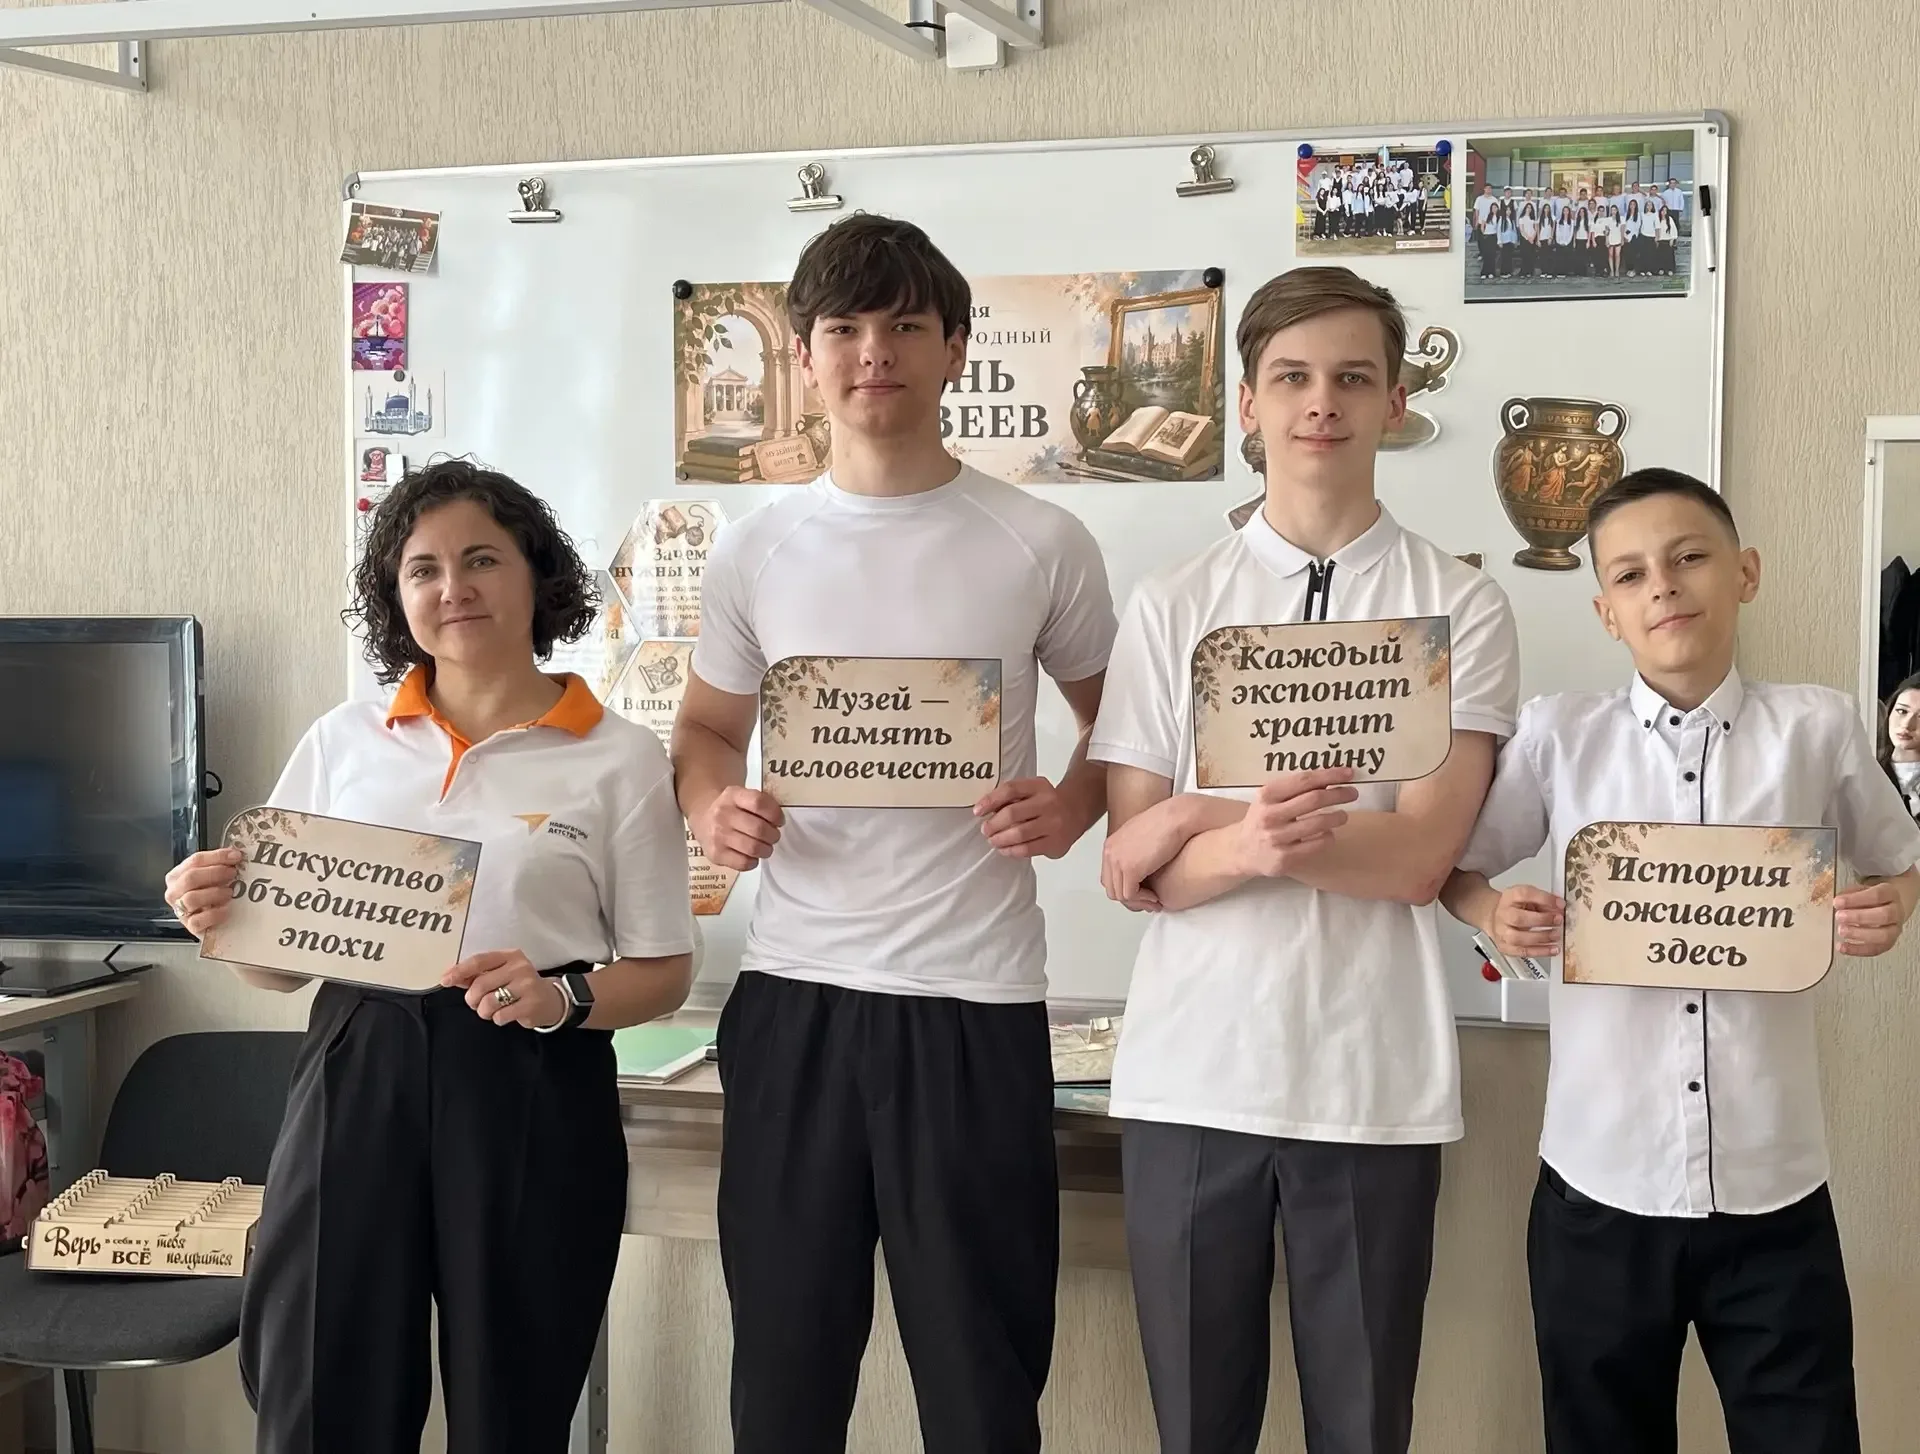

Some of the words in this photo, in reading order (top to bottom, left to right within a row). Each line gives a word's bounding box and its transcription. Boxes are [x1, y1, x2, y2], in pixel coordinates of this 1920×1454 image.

[1237, 636, 1404, 671] Каждый
[813, 686, 913, 717] Музей
[1231, 676, 1411, 705] экспонат
[811, 725, 953, 746] память
[1249, 712, 1394, 745] хранит
[768, 758, 995, 780] человечества
[1263, 742, 1385, 775] тайну
[250, 839, 445, 894] Искусство
[1607, 855, 1792, 893] История
[230, 878, 454, 934] объединяет
[1602, 899, 1795, 928] оживает
[278, 926, 386, 962] эпохи
[1646, 938, 1748, 967] здесь
[44, 1226, 101, 1266] Верь
[156, 1233, 187, 1249] тебя
[111, 1247, 152, 1265] ВСЁ
